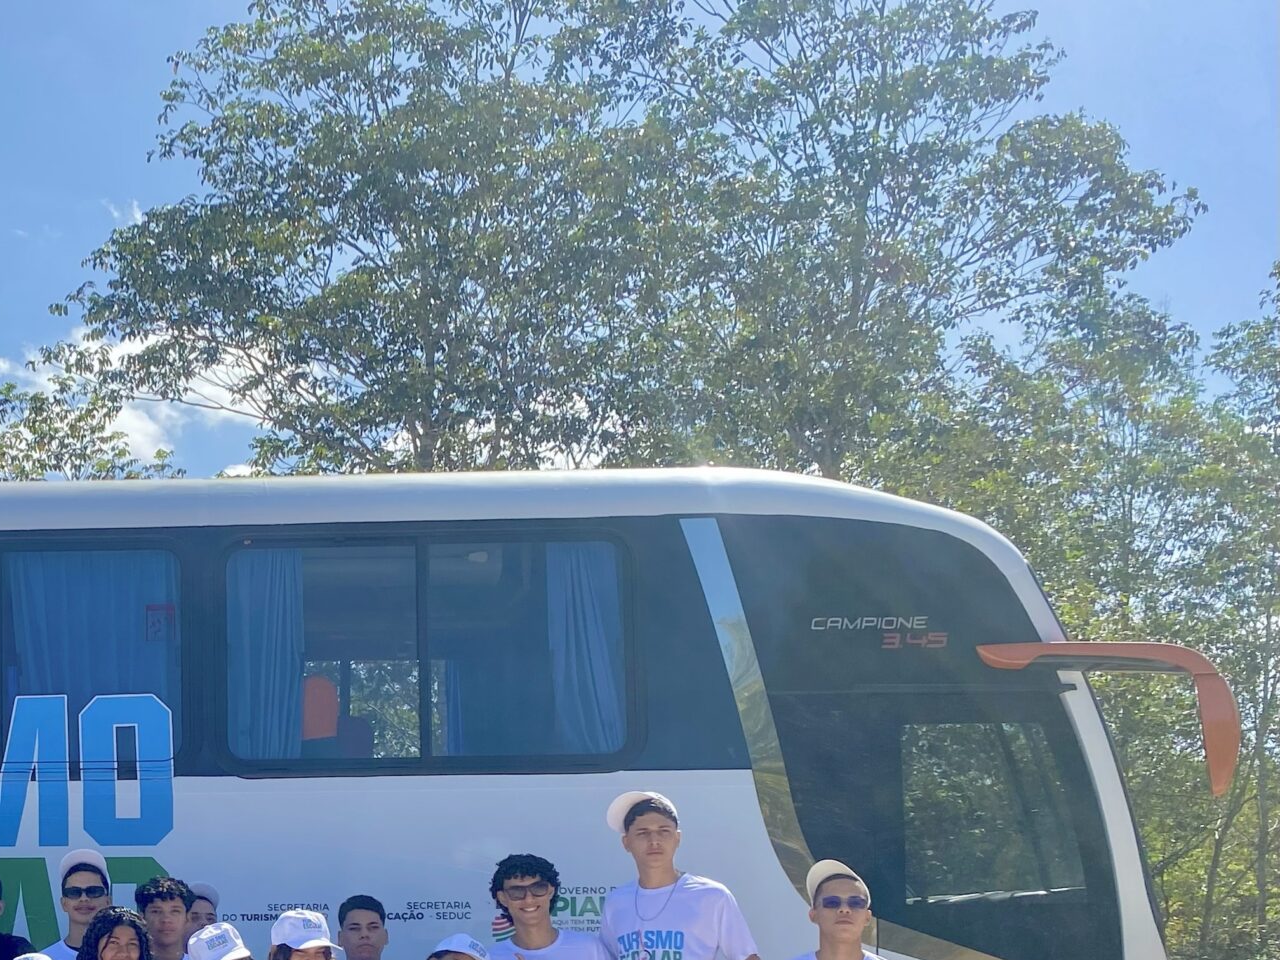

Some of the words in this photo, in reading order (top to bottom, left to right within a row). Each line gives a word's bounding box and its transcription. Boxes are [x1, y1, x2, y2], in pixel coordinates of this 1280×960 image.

[811, 616, 928, 630] CAMPIONE
[558, 886, 607, 895] OVERNO
[267, 903, 330, 912] SECRETARIA
[406, 901, 472, 910] SECRETARIA
[222, 914, 237, 922] DO
[435, 911, 472, 920] SEDUC
